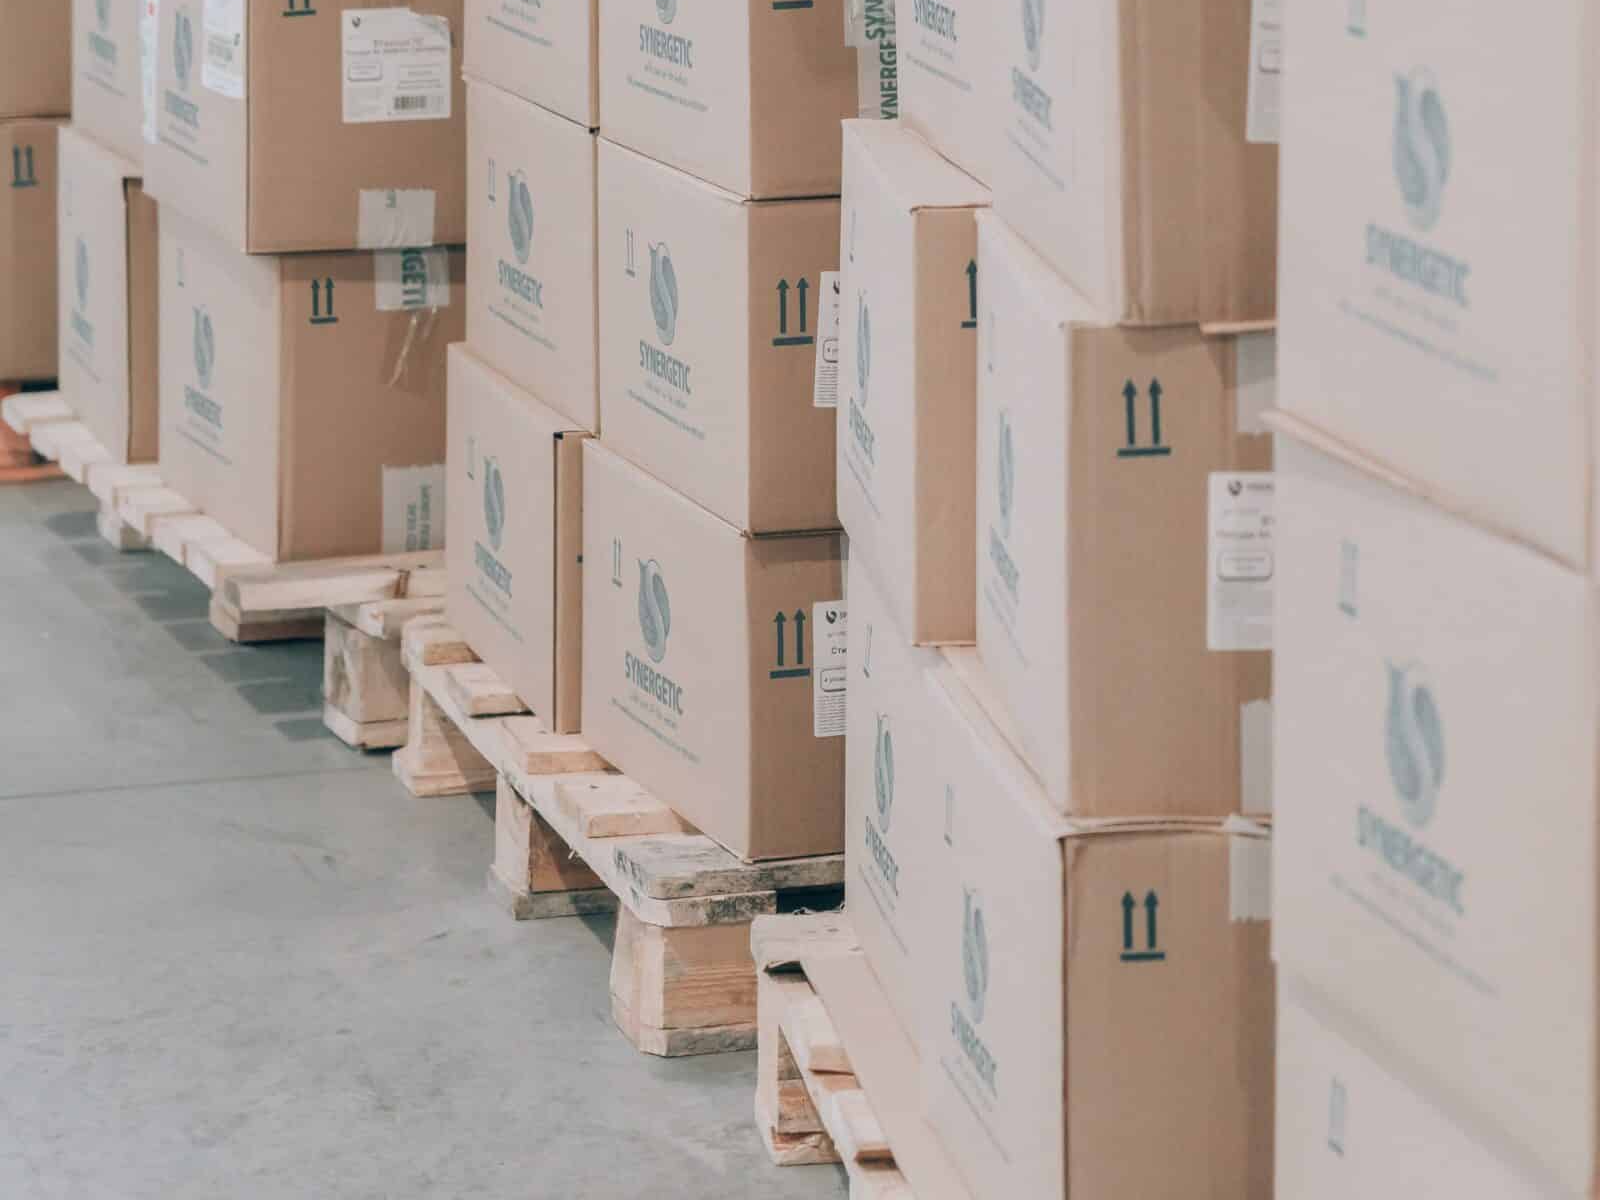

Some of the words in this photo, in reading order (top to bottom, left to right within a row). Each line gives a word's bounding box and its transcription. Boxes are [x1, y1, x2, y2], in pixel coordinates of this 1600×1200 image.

[639, 23, 693, 70] SYNERGETIC
[639, 339, 692, 396] SYNERGETIC
[624, 650, 684, 717] SYNERGETIC
